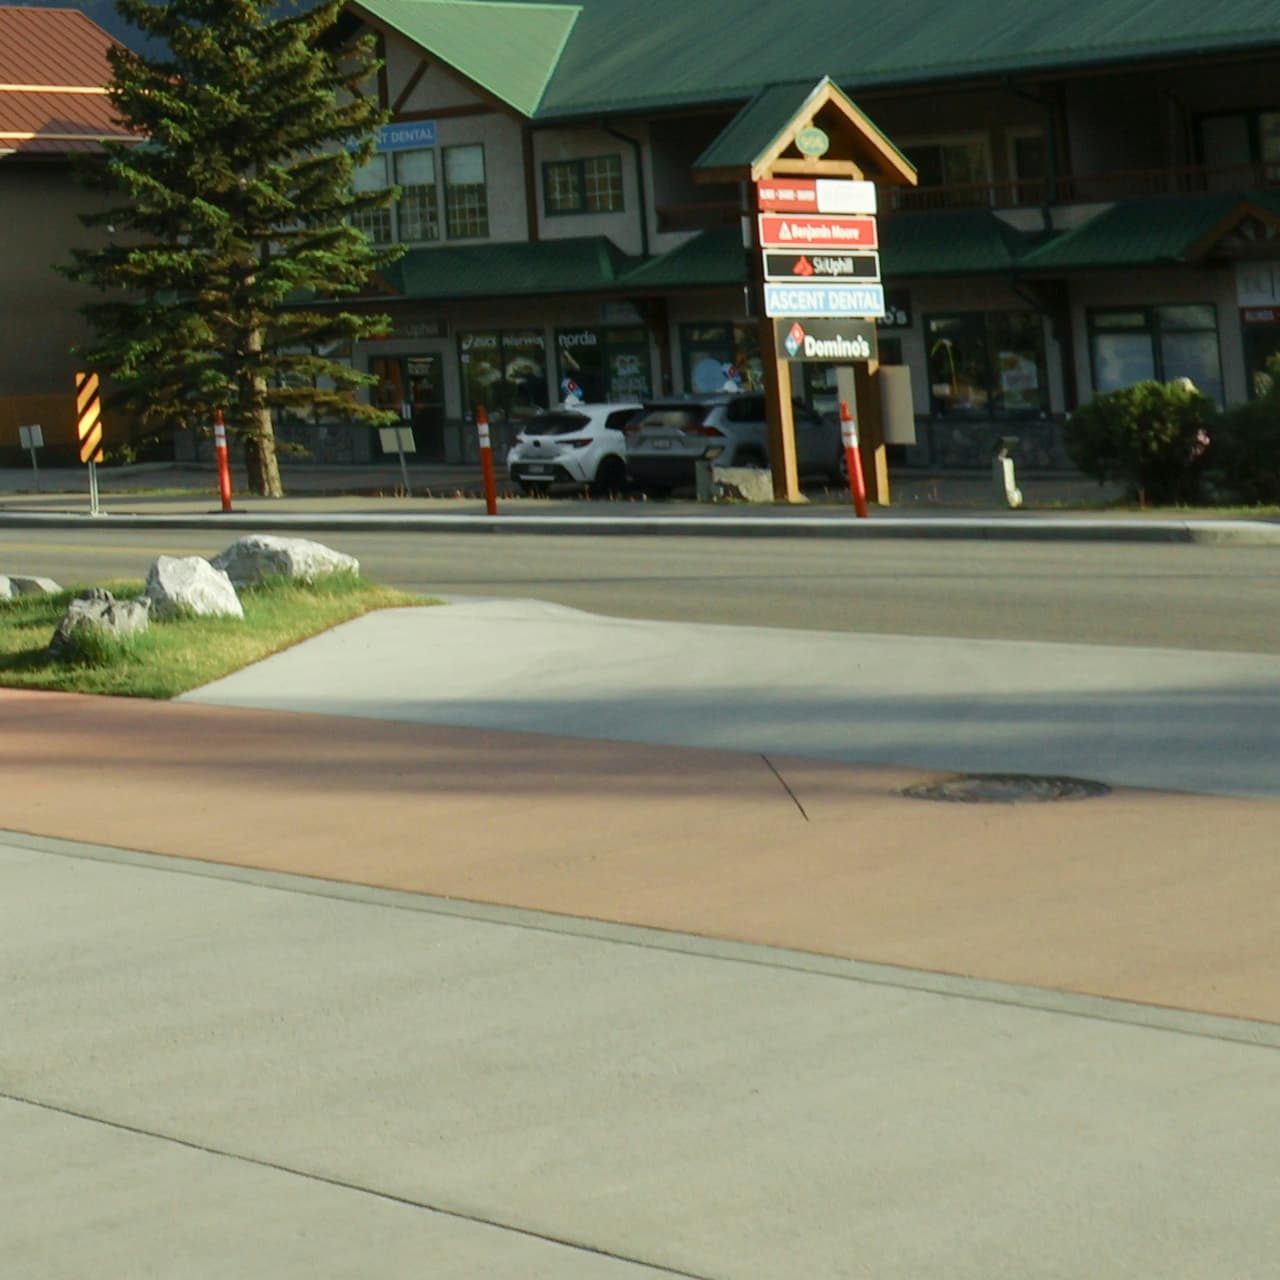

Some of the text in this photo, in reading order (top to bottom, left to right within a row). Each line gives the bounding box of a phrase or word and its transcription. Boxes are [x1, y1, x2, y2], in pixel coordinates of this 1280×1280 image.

[391, 127, 434, 144] DENTAL
[791, 223, 860, 242] Benjamin Moore
[770, 291, 881, 310] ASCENT DENTAL
[804, 334, 870, 357] Domino's
